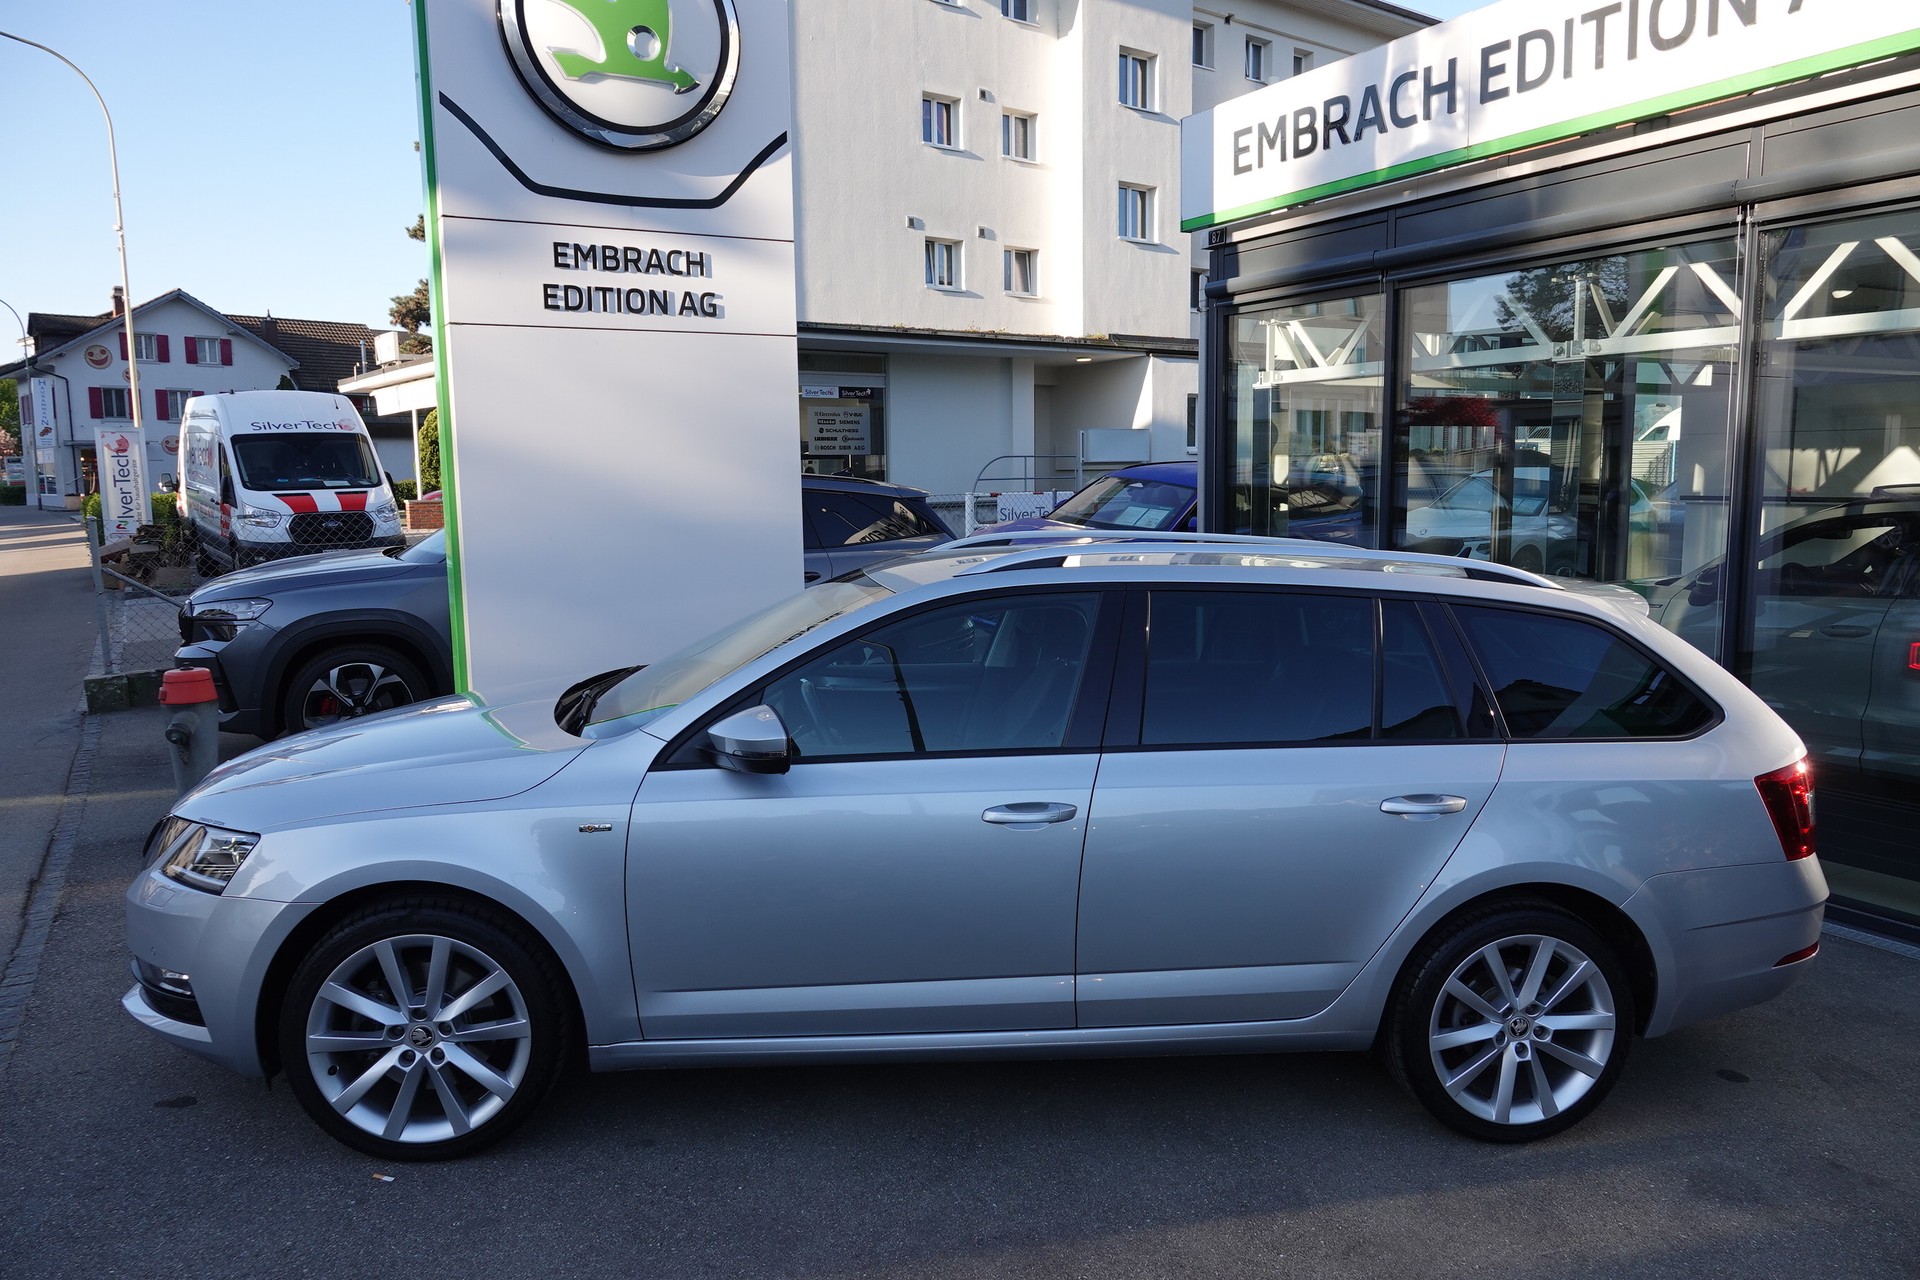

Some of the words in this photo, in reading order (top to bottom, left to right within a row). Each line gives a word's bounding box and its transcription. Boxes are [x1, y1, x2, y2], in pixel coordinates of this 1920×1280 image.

[1232, 55, 1458, 176] EMBRACH
[1479, 0, 1758, 105] EDITION
[1211, 230, 1221, 244] 87
[553, 241, 706, 277] EMBRACH
[543, 283, 668, 316] EDITION
[678, 290, 718, 318] AG
[250, 420, 344, 431] SilverTech
